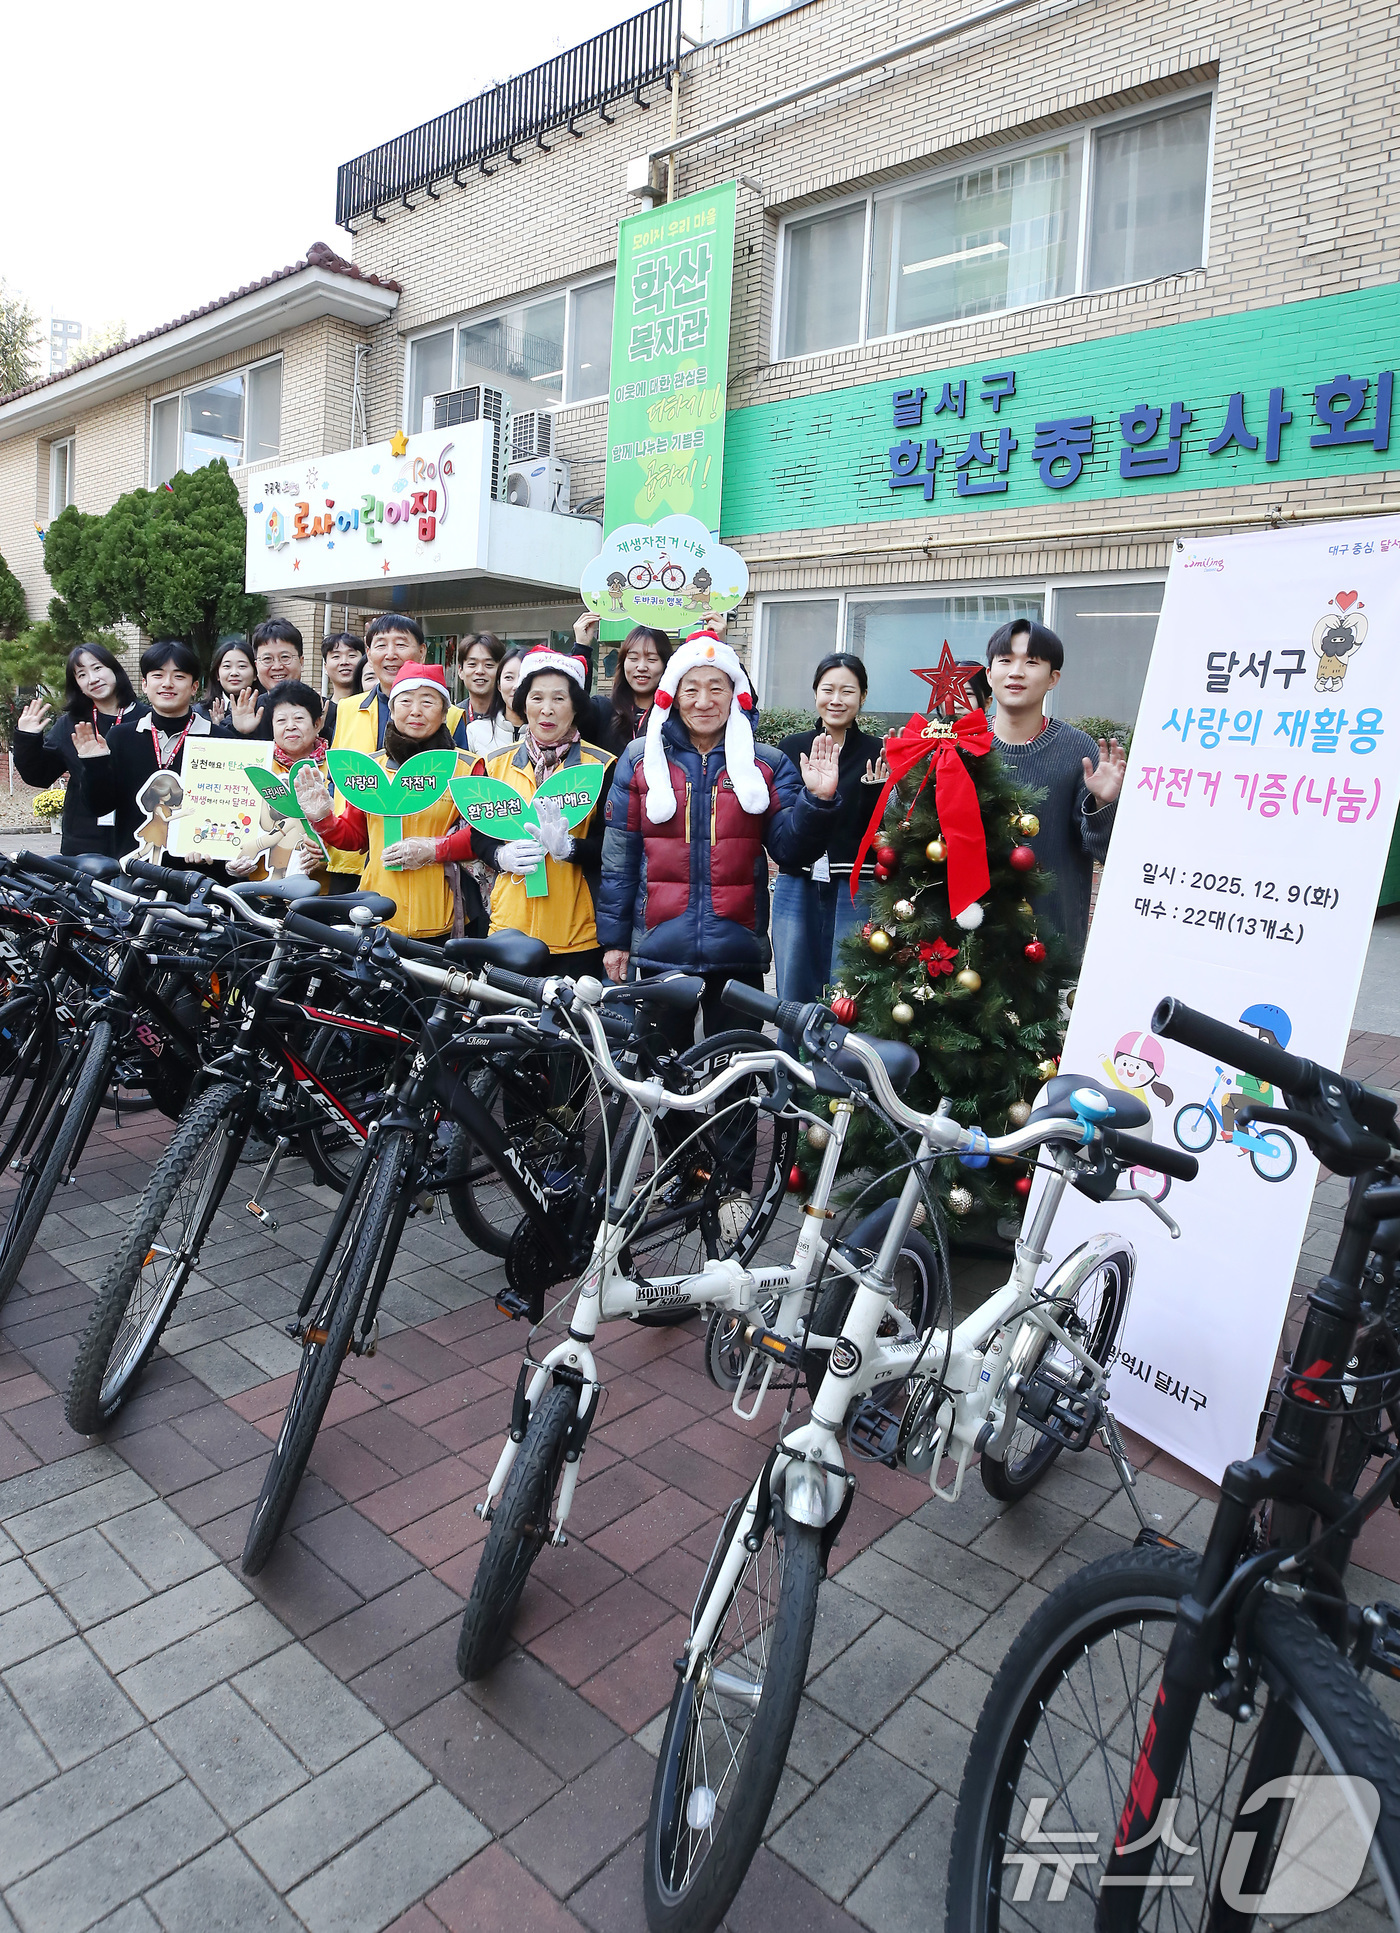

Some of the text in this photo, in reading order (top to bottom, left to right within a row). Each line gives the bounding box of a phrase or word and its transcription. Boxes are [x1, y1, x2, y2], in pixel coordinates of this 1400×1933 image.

[632, 207, 716, 250] 모이자 우리 마을
[632, 242, 712, 315] 학산
[628, 308, 710, 362] 복지관
[614, 367, 708, 403] 이웃에 대한 관심은
[893, 370, 1016, 428] 달서구
[612, 429, 704, 463] 함께 나누는 기쁨은
[616, 535, 707, 558] 재생자전거 나눔
[1328, 544, 1349, 556] 대구
[633, 595, 684, 607] 두바퀴의 행복
[1206, 649, 1306, 693] 달서구
[1162, 706, 1385, 755] 사랑의 재활용
[190, 758, 226, 770] 실천해요!
[197, 783, 221, 793] 버려진
[262, 785, 288, 800] 그린시티
[344, 775, 437, 790] 사랑의 자전거
[1137, 766, 1381, 824] 자전거 기증(나눔)
[190, 795, 218, 806] 재생해서
[232, 797, 256, 807] 달려요
[467, 798, 522, 820] 환경실천
[1142, 862, 1176, 885] 일시
[1190, 871, 1245, 898] 2025.
[1254, 880, 1279, 902] 12.
[1287, 884, 1340, 911] 9(화)
[1134, 896, 1167, 921] 대수
[1182, 905, 1304, 945] 22대(13개소)
[503, 1147, 549, 1214] ALTON
[875, 1370, 893, 1379] CTS
[1154, 1369, 1208, 1411] 달서구
